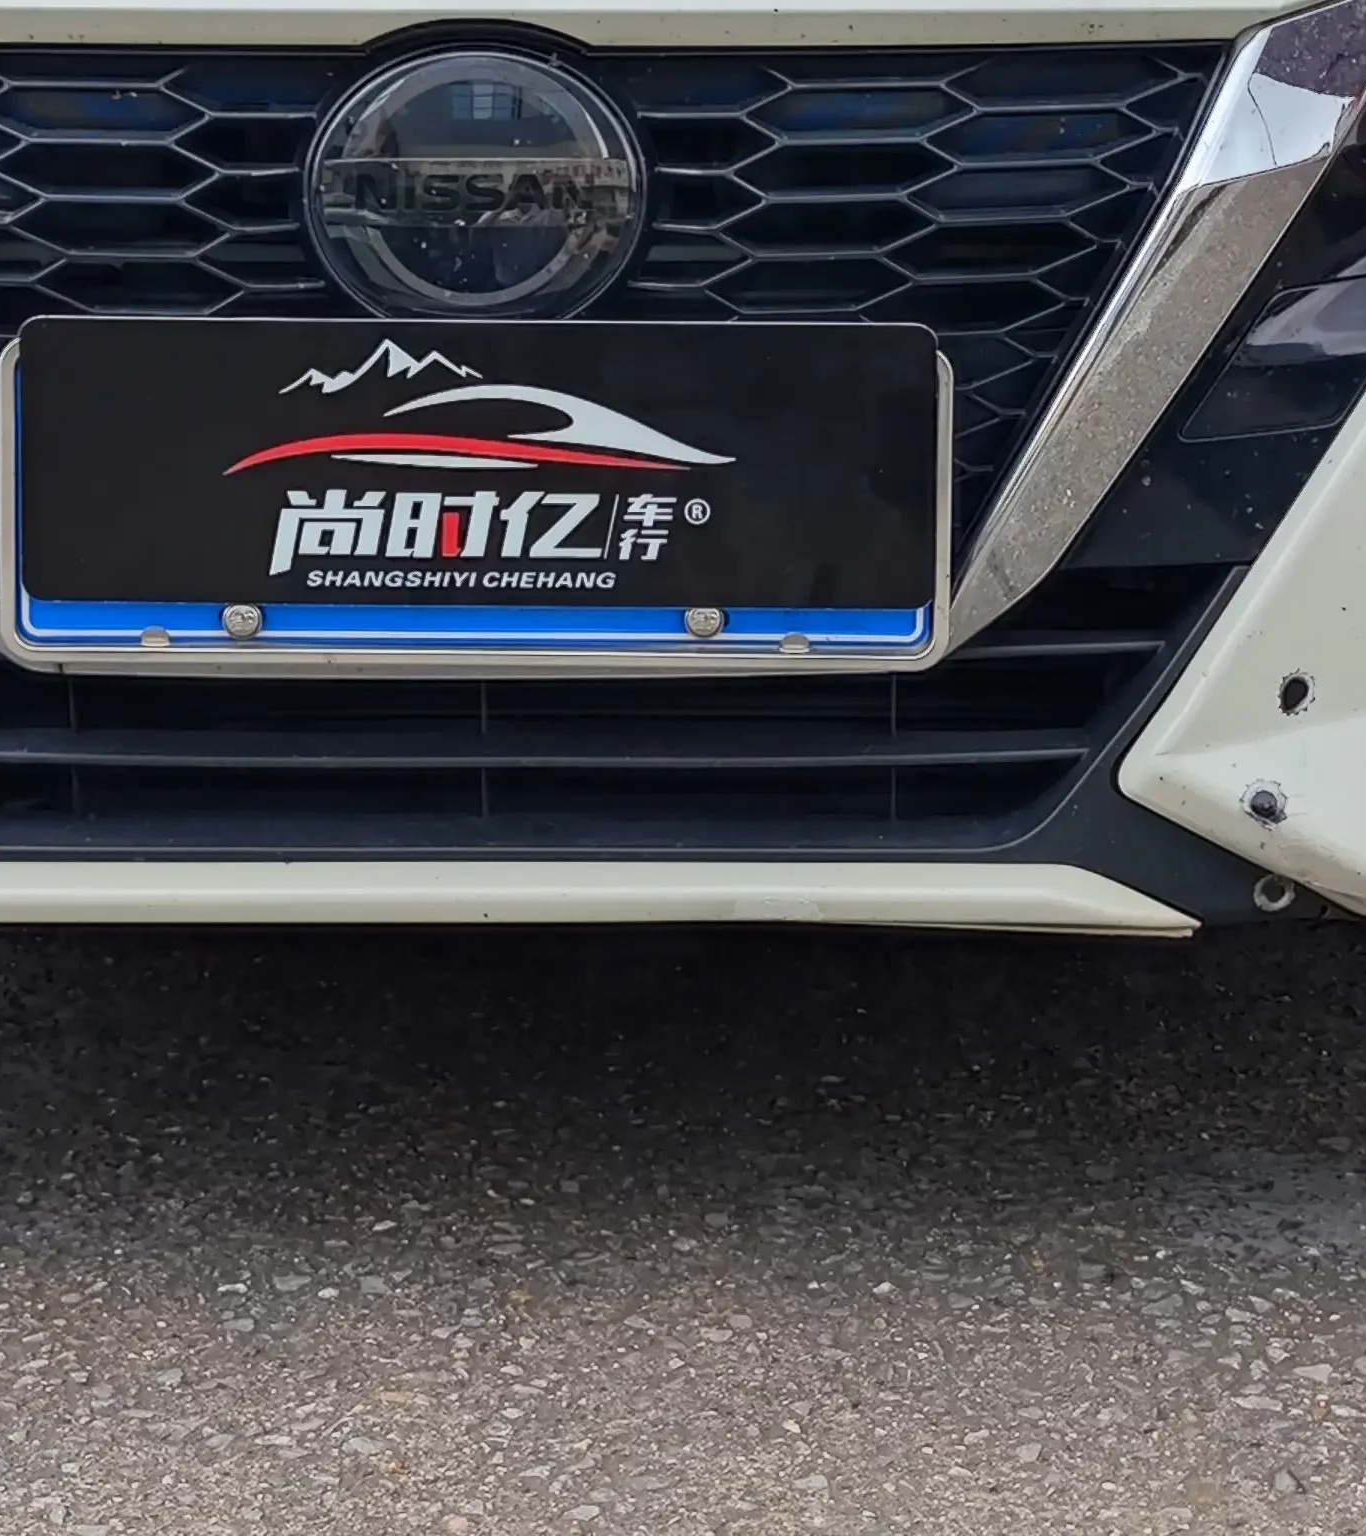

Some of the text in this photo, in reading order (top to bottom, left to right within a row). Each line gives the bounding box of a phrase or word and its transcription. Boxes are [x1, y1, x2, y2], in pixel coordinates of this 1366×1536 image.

[354, 173, 595, 211] NISSAN
[269, 489, 602, 576] 尚时亿
[307, 570, 616, 588] SHANGSHIYI CHEHANG
